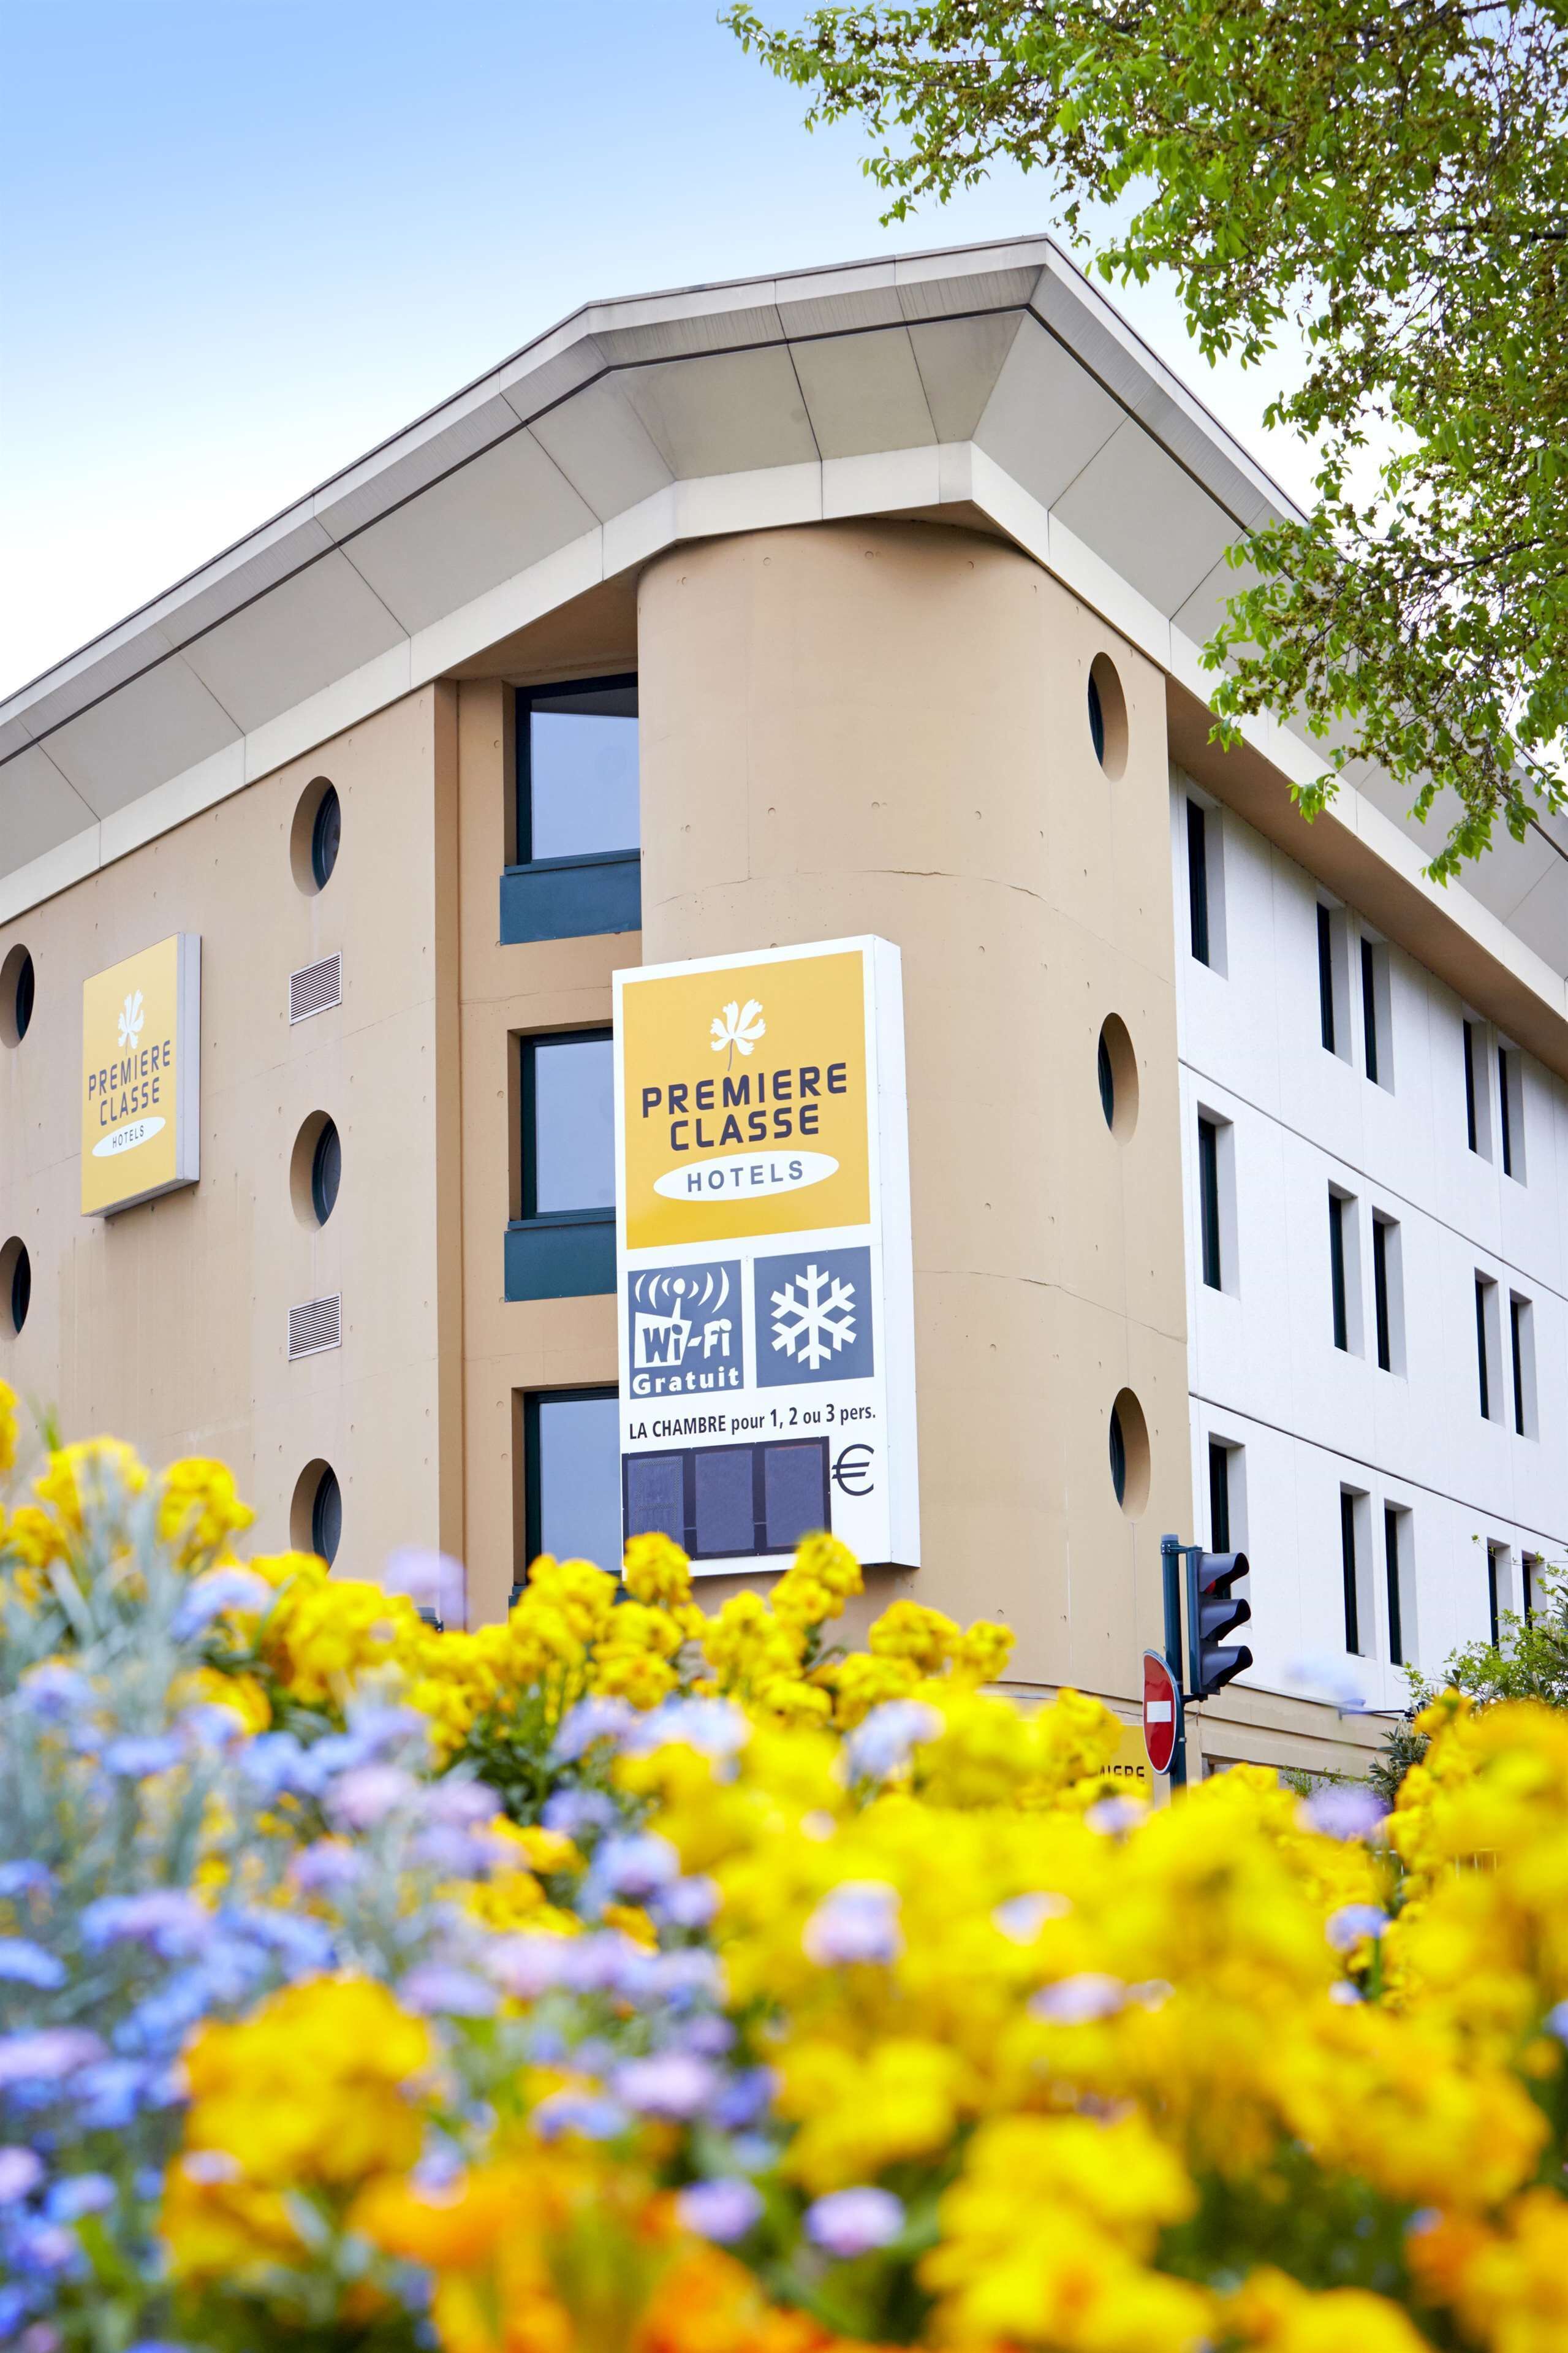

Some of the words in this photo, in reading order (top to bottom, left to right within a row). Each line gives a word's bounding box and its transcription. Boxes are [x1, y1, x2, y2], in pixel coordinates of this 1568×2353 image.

[89, 1040, 170, 1101] PREMIERE
[642, 1062, 847, 1119] PREMIERE
[100, 1076, 159, 1127] CLASSE
[112, 1125, 145, 1149] HOTELS
[670, 1103, 819, 1151] CLASSE
[687, 1160, 803, 1193] HOTELS
[642, 1318, 732, 1364] Wi-Fi
[632, 1366, 740, 1396] Gratuit
[629, 1422, 648, 1440] LA
[652, 1415, 726, 1438] CHAMBRE
[731, 1415, 765, 1435] pour
[770, 1408, 784, 1429] 1,
[789, 1407, 798, 1426] 2
[803, 1410, 821, 1424] ou
[826, 1403, 835, 1423] 3
[840, 1405, 876, 1426] pers.
[831, 1443, 875, 1497] €
